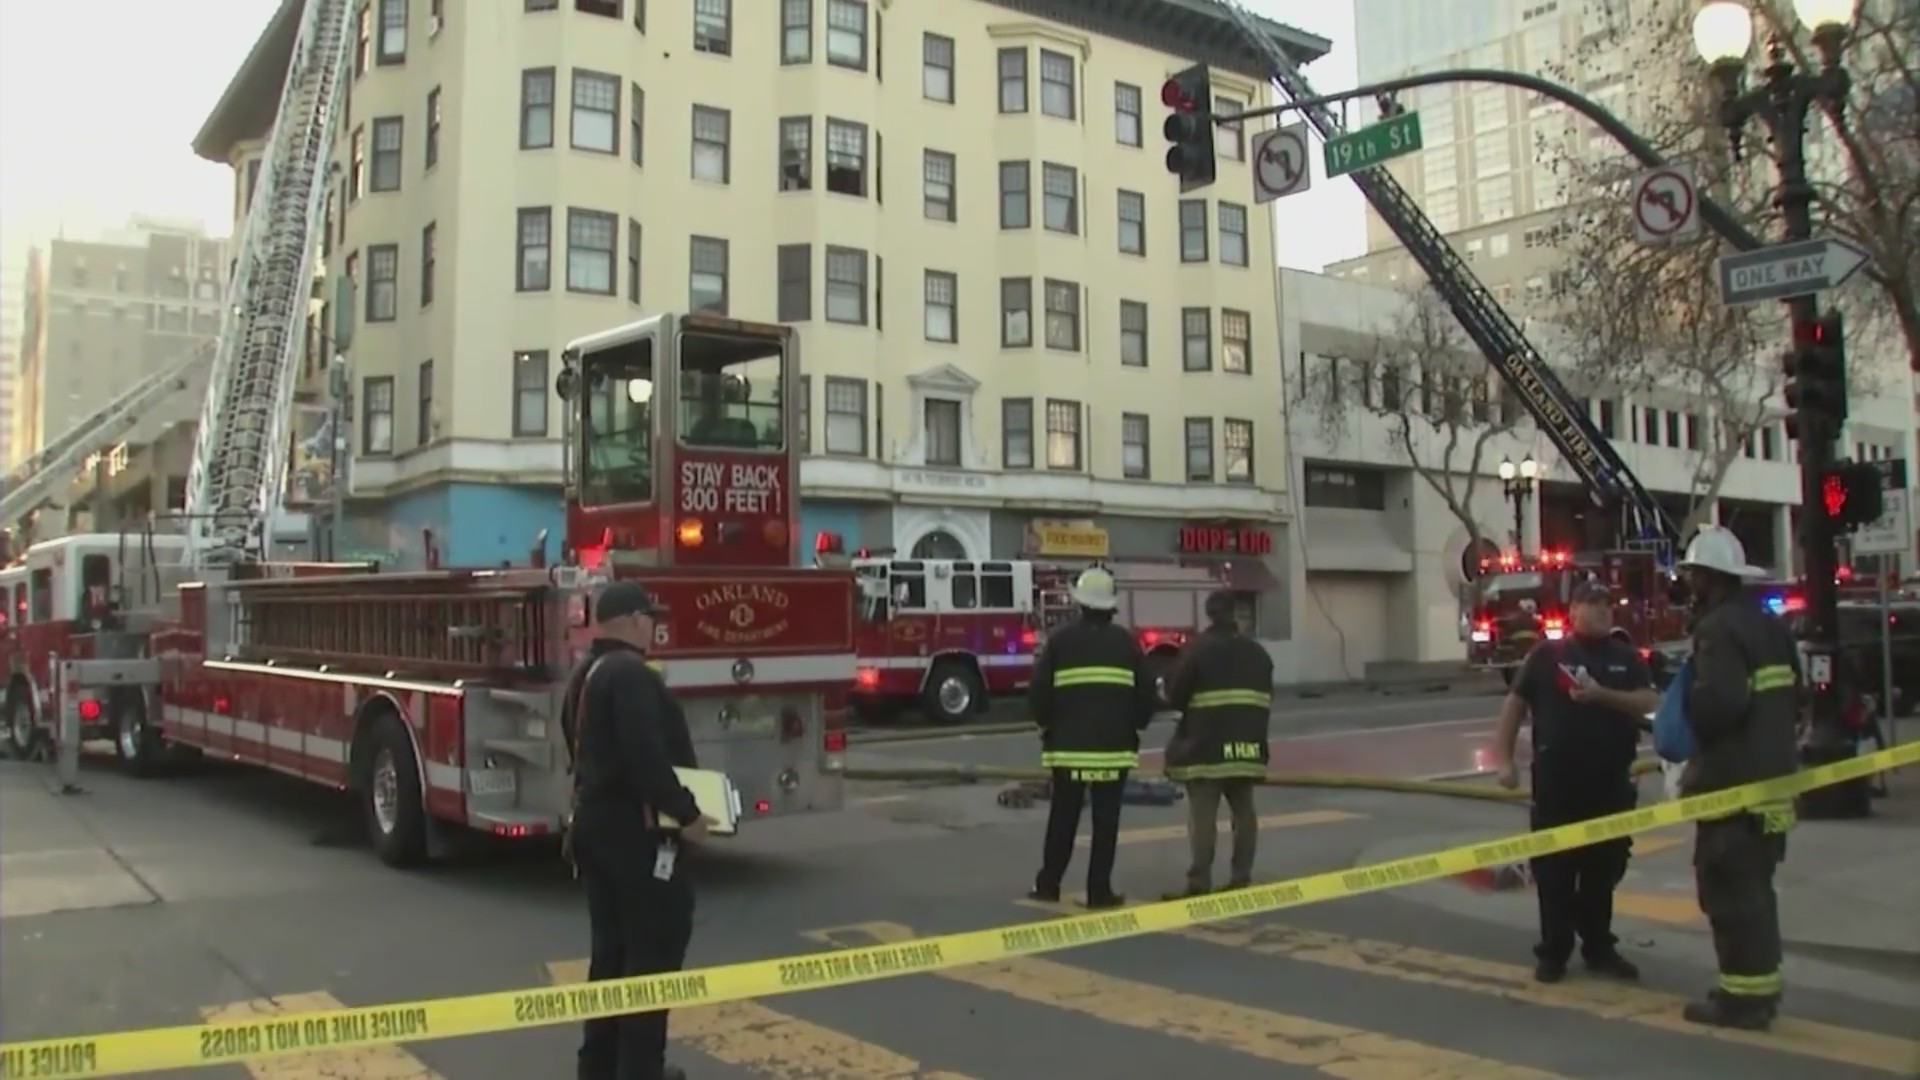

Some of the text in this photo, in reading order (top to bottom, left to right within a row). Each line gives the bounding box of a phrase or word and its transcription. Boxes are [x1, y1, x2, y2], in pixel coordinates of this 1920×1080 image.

[1390, 124, 1411, 149] St
[1736, 255, 1825, 289] ONE WAY
[1506, 354, 1596, 466] OAKLAND FIRE
[681, 461, 780, 488] STAY BACK
[681, 487, 718, 511] 300
[725, 489, 769, 512] FEET
[695, 584, 789, 610] OAKLAND
[1235, 741, 1262, 759] HUNT
